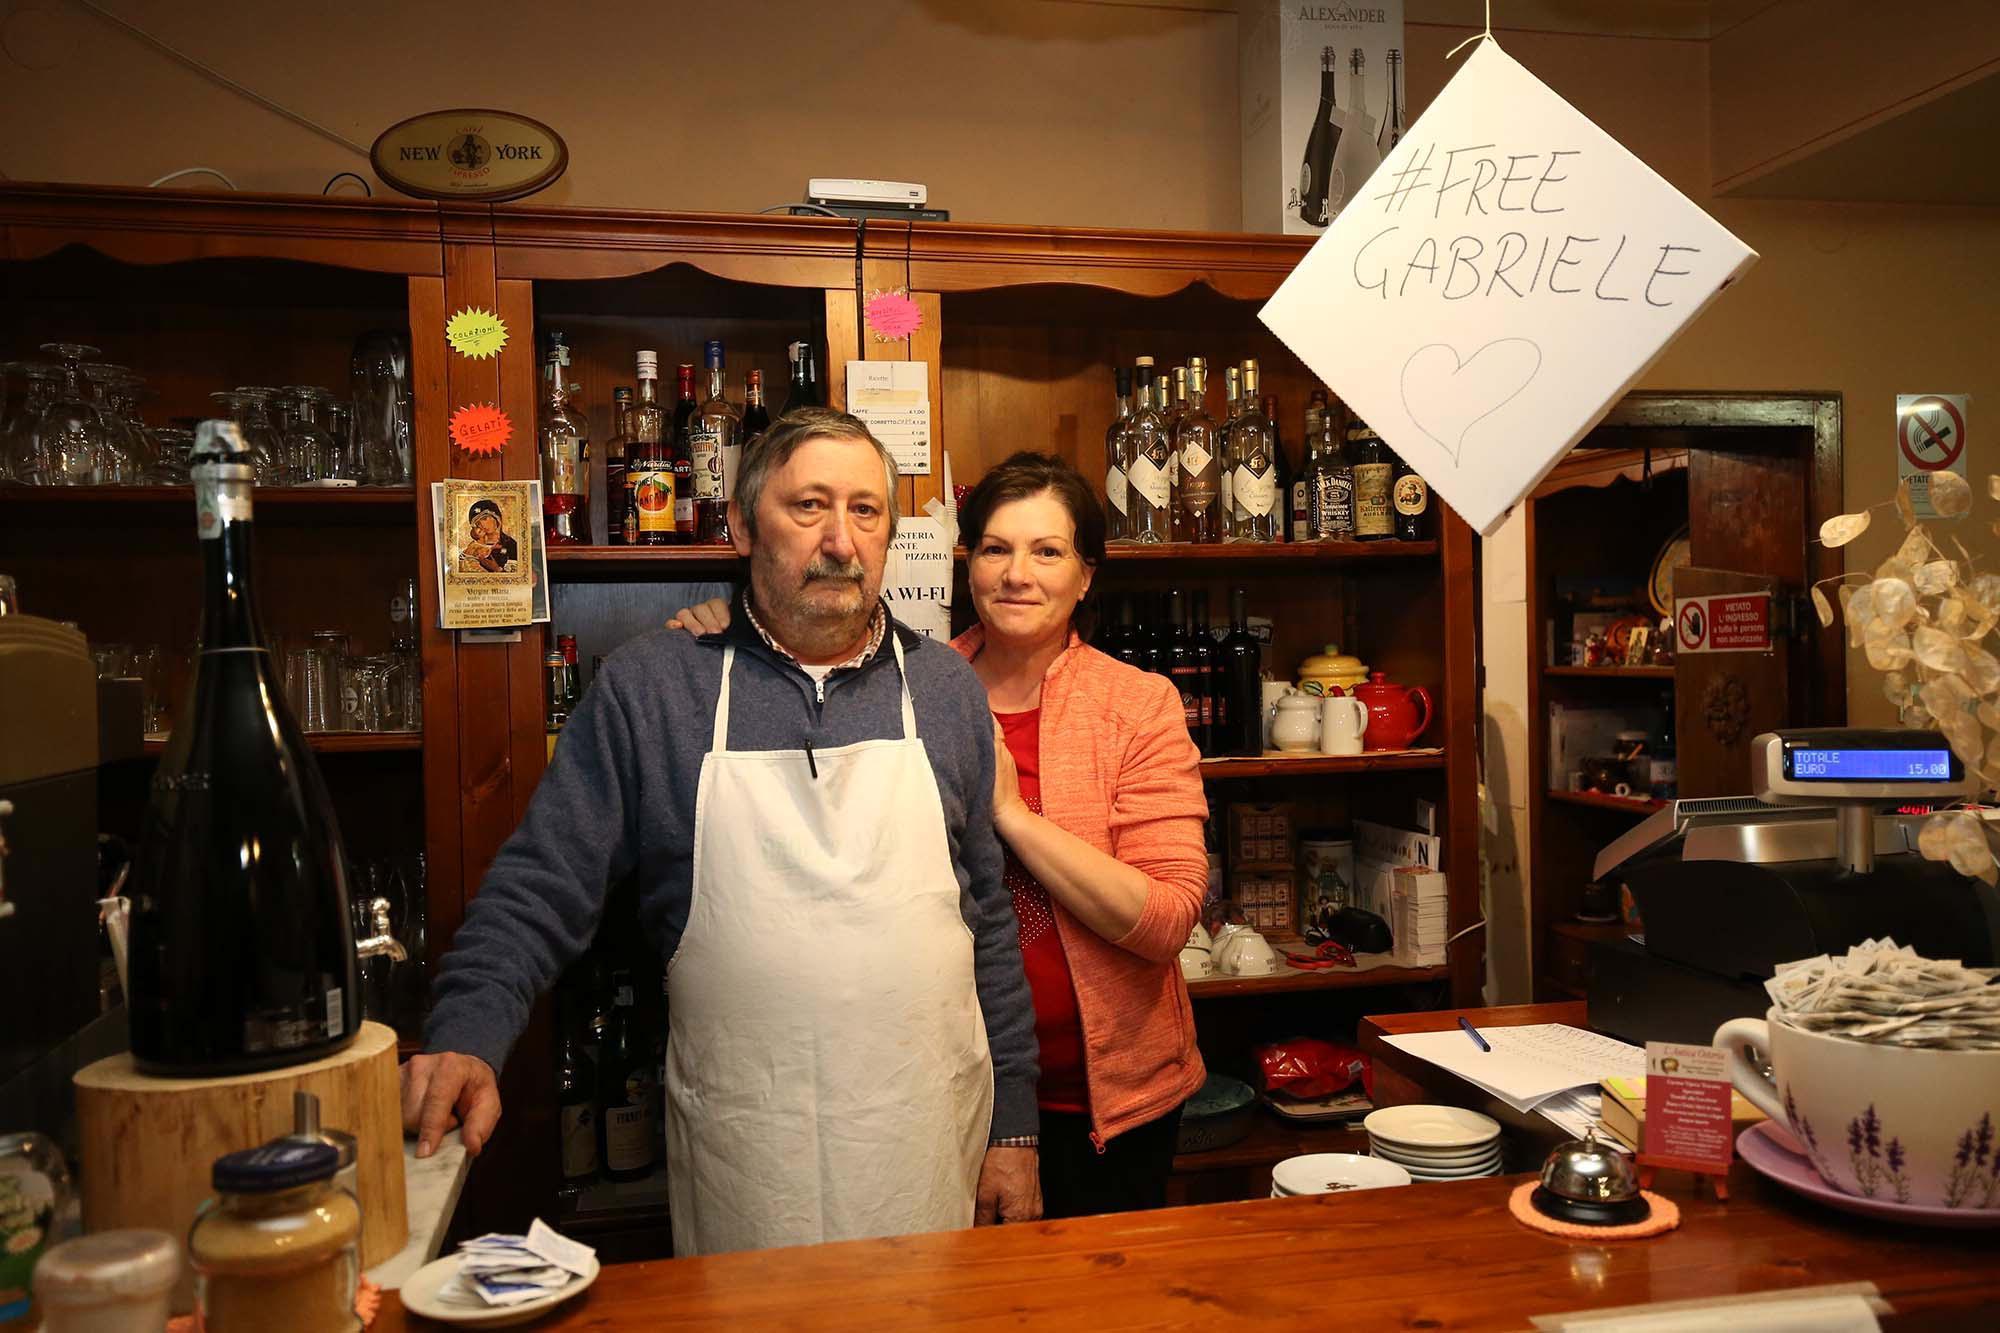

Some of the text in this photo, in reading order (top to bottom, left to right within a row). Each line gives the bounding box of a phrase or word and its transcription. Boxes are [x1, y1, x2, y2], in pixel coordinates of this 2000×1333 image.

[1299, 6, 1385, 23] ALEXANDER
[400, 144, 543, 161] NEW YORK
[1374, 143, 1581, 219] #FREE
[1353, 226, 1702, 307] GABRIELE
[905, 552, 948, 561] PIZZERIA
[898, 586, 946, 601] WI-FI
[1725, 602, 1752, 611] VIETATO
[1796, 752, 1841, 764] TOTALE
[1796, 763, 1947, 775] EURO 15,00
